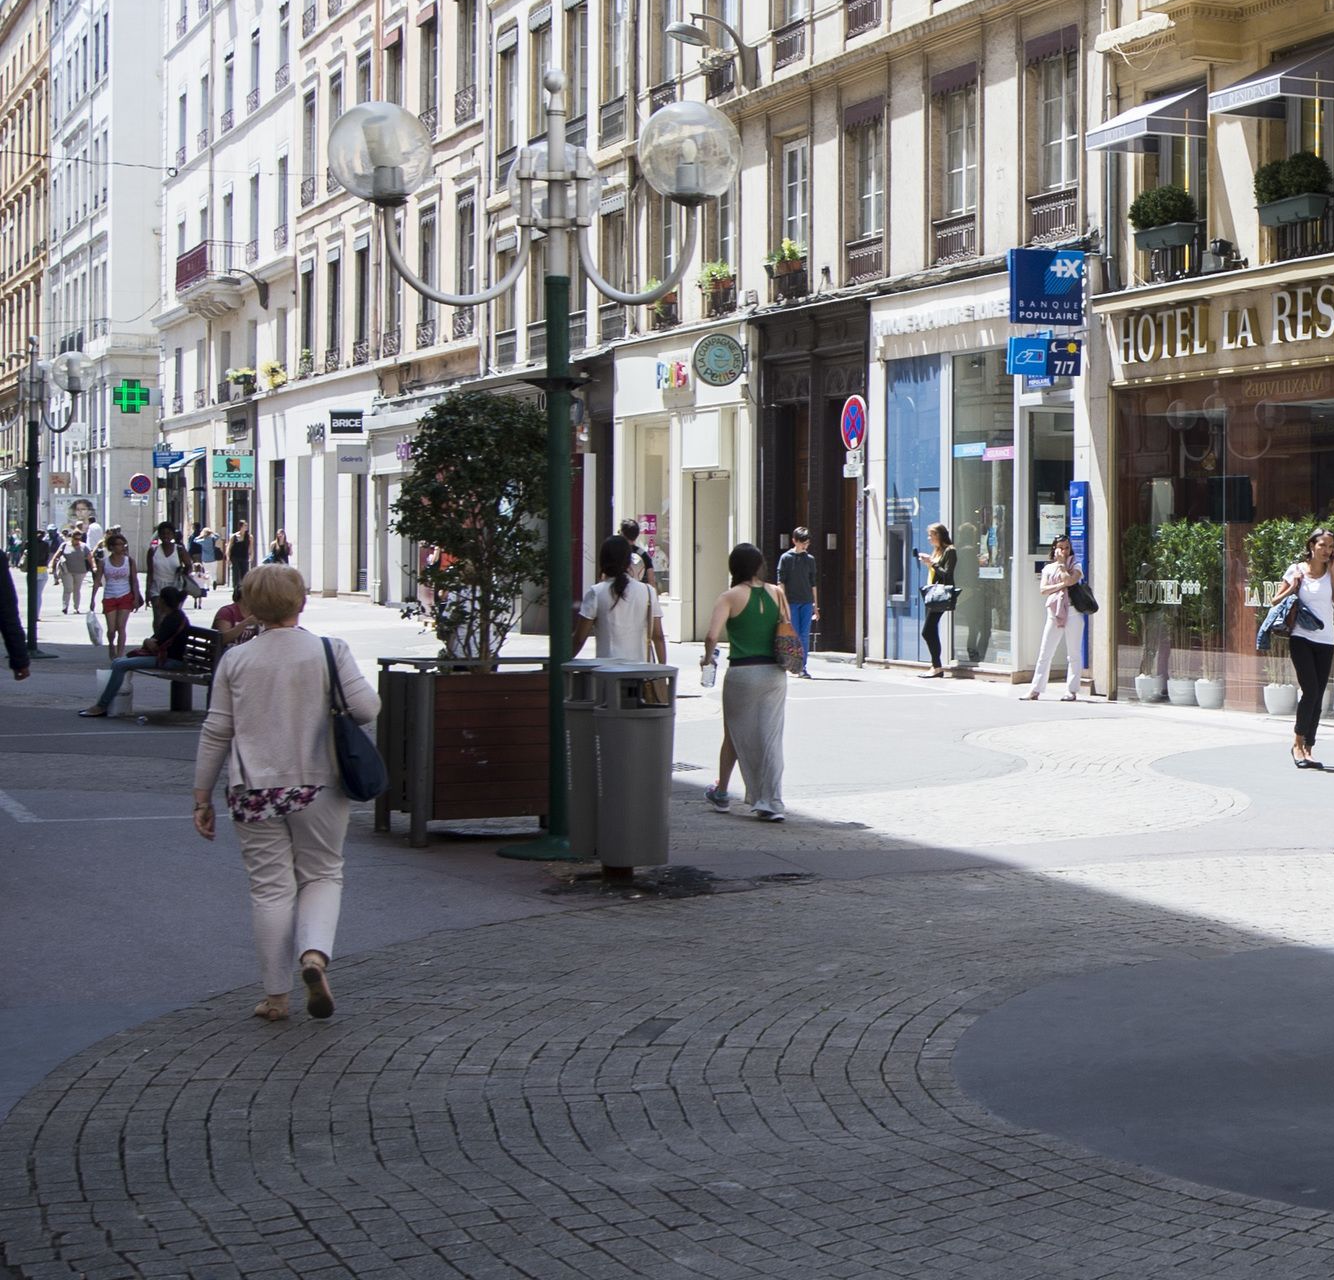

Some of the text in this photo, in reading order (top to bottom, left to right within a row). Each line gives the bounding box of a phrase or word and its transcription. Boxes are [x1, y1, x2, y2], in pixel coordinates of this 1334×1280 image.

[1229, 81, 1277, 104] RESIDENCE
[1019, 300, 1079, 310] BANQUE
[1019, 311, 1079, 321] POPULAIRE
[1117, 304, 1210, 366] HOTEL
[1221, 307, 1260, 351] LA
[701, 337, 739, 357] COMPAGNIE
[1054, 360, 1076, 374] 7/7
[331, 418, 362, 428] BRICE
[223, 448, 250, 456] CEDER
[212, 471, 253, 479] Concorde
[1136, 579, 1183, 605] HOTEL
[1244, 585, 1262, 608] LA
